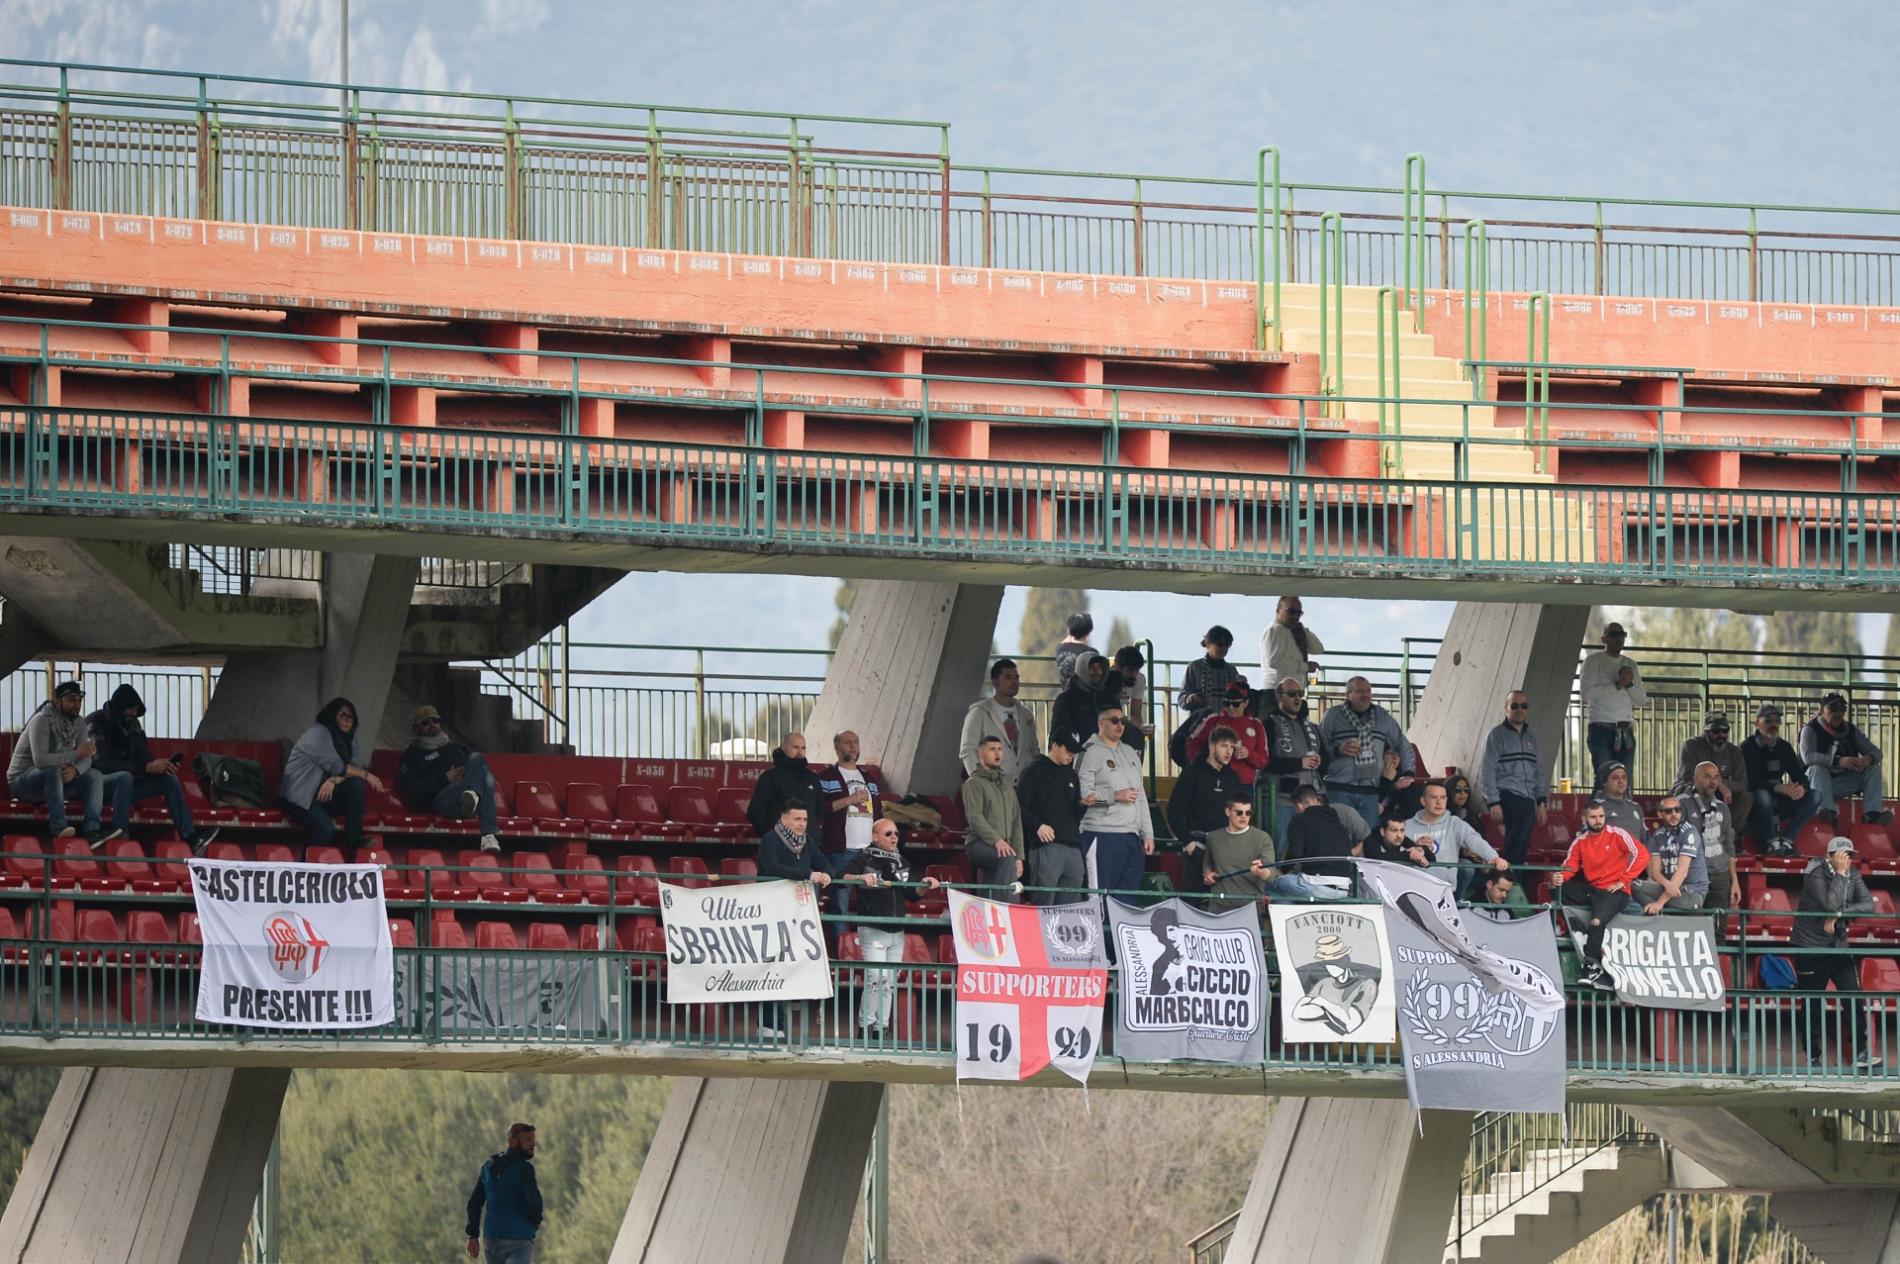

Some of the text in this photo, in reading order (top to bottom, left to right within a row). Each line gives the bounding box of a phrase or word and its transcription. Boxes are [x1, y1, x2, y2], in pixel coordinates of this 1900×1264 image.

[192, 866, 378, 904] CASTELCERIOLO
[701, 896, 762, 921] Ultras
[667, 919, 822, 965] SBRINZA'S
[1057, 925, 1087, 942] 99
[1317, 926, 1342, 934] 2000
[1126, 930, 1149, 995] ALESSANDRIA
[1184, 934, 1245, 964] GRIGI CLUB
[705, 970, 786, 992] Alessandria
[962, 970, 1102, 999] SUPPORTERS
[1187, 965, 1251, 996] CICCIO
[224, 984, 339, 1022] PRESENTE
[1425, 983, 1479, 1021] 99
[966, 1022, 1013, 1063] 19
[1424, 1051, 1506, 1069] ALESSANDRIA
